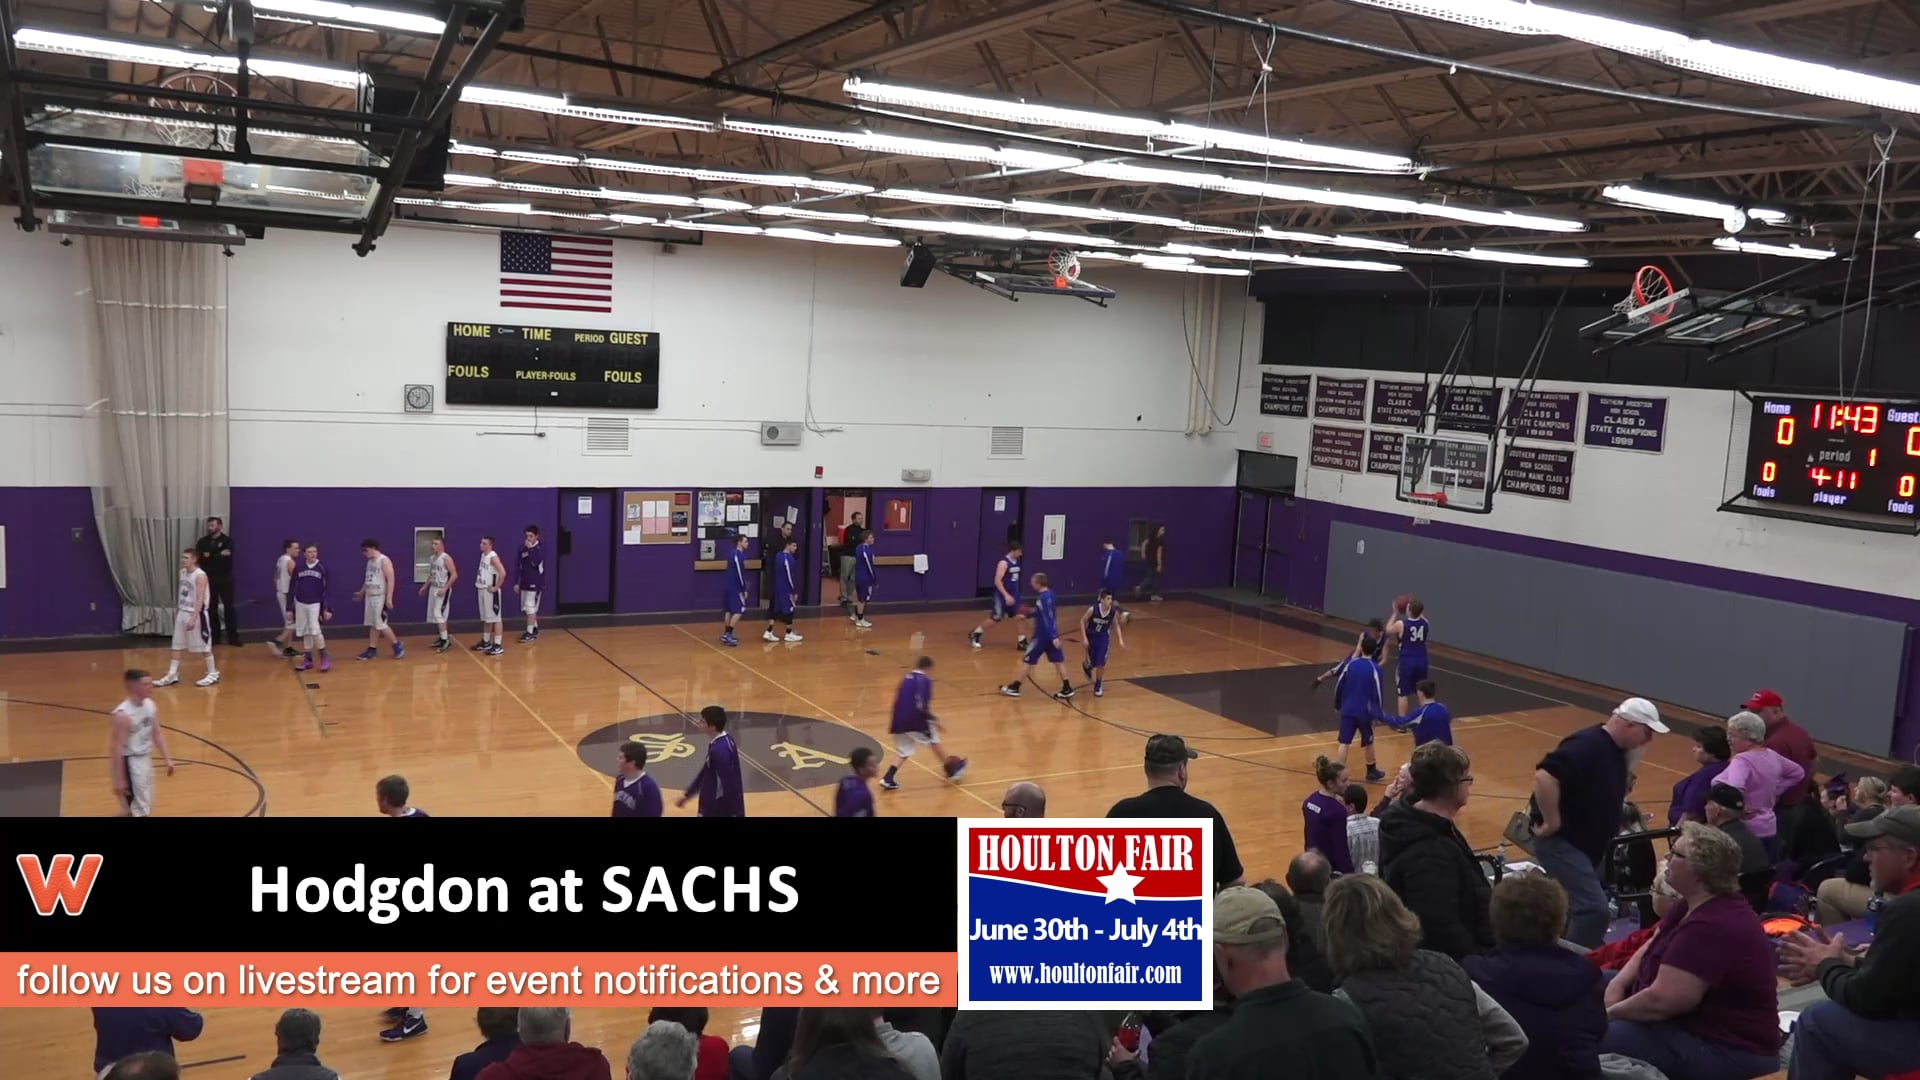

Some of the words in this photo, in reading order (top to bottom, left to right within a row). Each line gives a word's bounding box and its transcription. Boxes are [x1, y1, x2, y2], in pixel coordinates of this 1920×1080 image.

[453, 323, 491, 338] HOME
[522, 327, 552, 341] TIME
[574, 332, 604, 344] PERIOD
[609, 331, 649, 346] GUEST
[448, 364, 490, 379] FOULS
[604, 370, 642, 384] FOULS
[1763, 401, 1792, 415] Home
[1603, 415, 1635, 426] CLASS
[1638, 418, 1646, 427] D
[1811, 403, 1880, 434] 11:43
[1887, 408, 1920, 424] Guest
[1533, 420, 1570, 430] CHAMPIONS
[1590, 424, 1613, 434] STATE
[1616, 426, 1658, 438] CHAMPIONS
[1776, 417, 1795, 446] 0
[1819, 449, 1851, 463] period
[1868, 448, 1878, 467] 1
[1762, 461, 1776, 482] 0
[1505, 479, 1546, 493] CHAMPIONS
[1548, 485, 1565, 496] 1991
[1753, 485, 1776, 498] fouls
[1899, 475, 1915, 497] 0
[1813, 491, 1847, 505] player
[1887, 499, 1915, 514] fouls
[1410, 626, 1424, 642] 34
